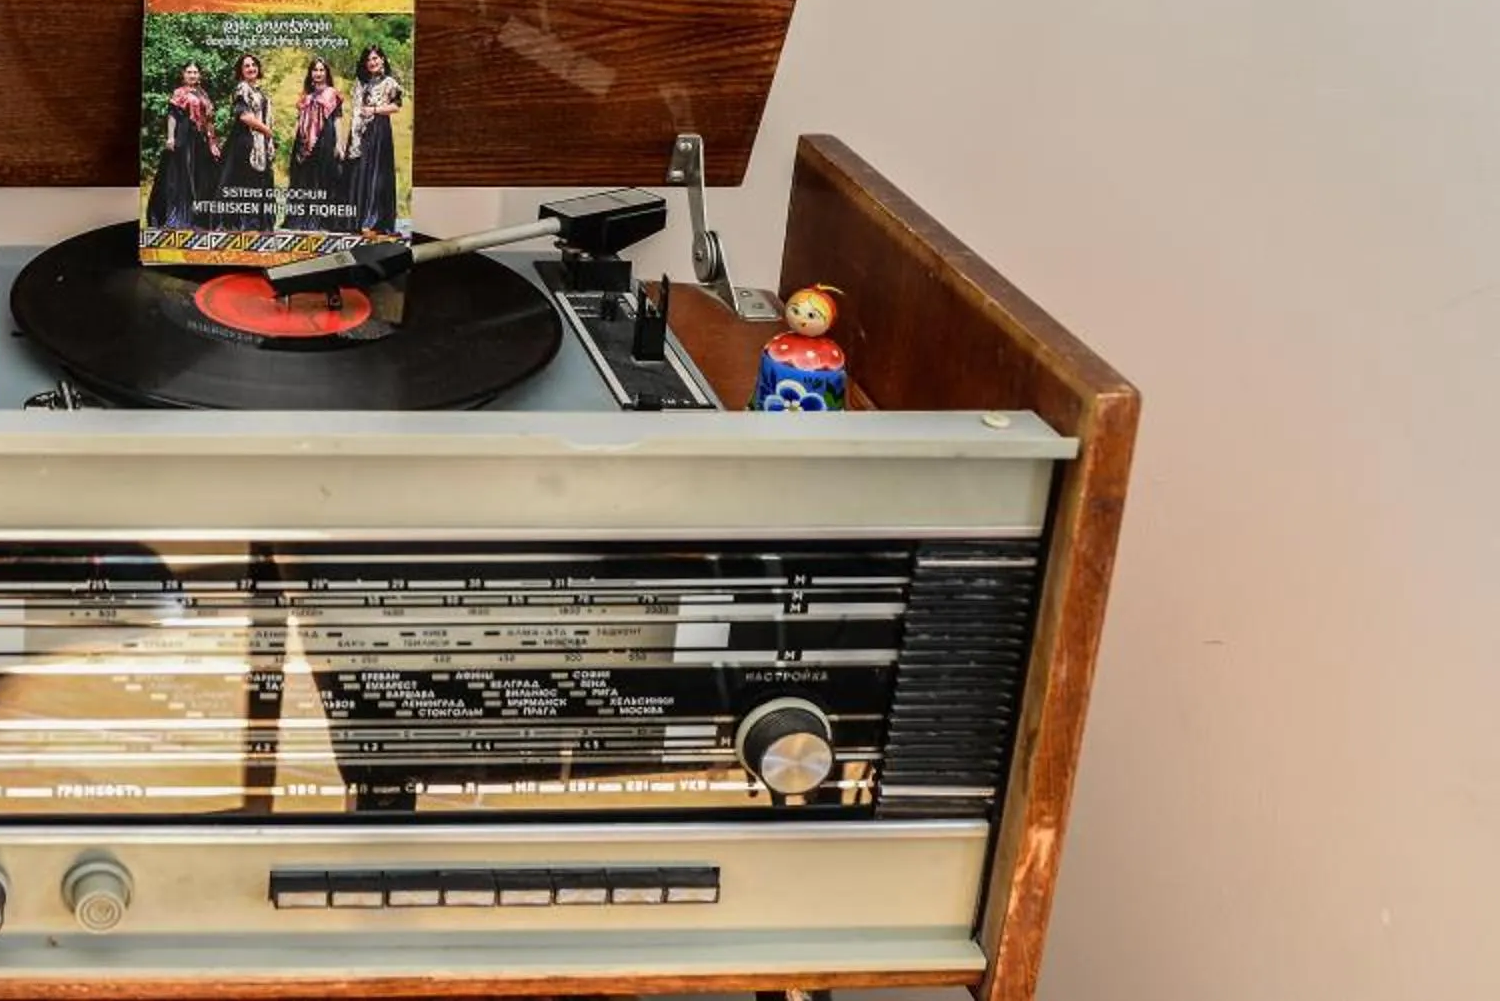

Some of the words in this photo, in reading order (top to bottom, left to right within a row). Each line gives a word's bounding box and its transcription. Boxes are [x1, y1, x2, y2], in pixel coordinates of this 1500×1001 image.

[222, 186, 263, 198] SISTERS
[265, 187, 328, 200] GOGOCHURI
[192, 200, 260, 215] MTEBISKEN
[309, 203, 358, 218] FIQREBI
